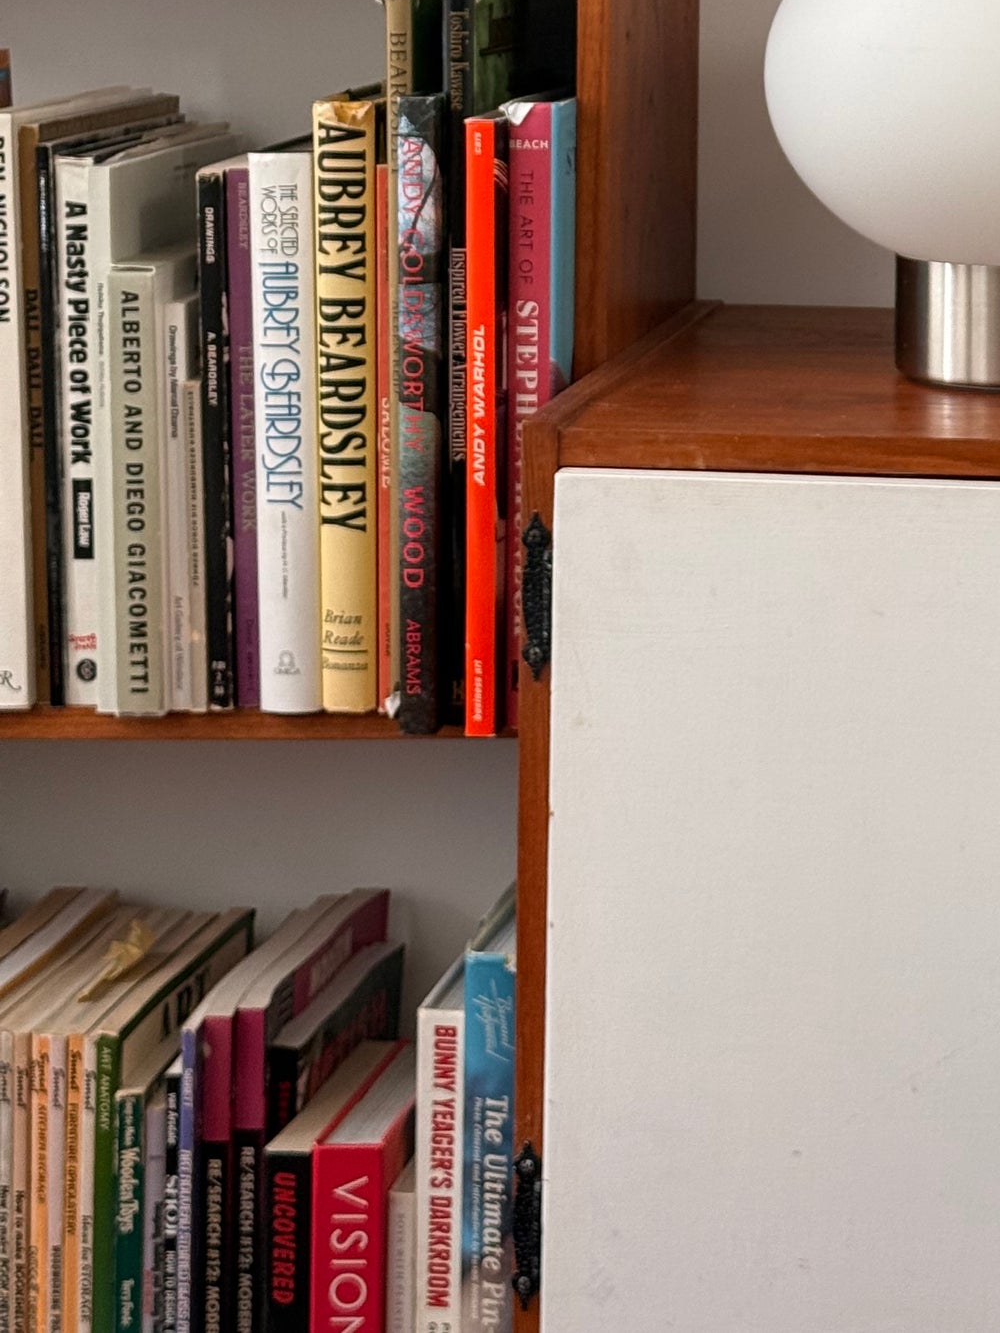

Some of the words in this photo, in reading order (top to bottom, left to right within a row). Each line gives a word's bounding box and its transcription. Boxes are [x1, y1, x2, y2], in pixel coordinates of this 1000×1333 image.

[449, 8, 469, 57] Toshiro
[449, 61, 469, 110] Kawase
[509, 140, 549, 151] BEACH
[279, 184, 298, 202] THE
[318, 121, 367, 283] AUBREY
[402, 137, 424, 218] ANDY
[520, 171, 534, 205] THE
[65, 201, 87, 218] A
[205, 207, 215, 264] DRAWINGS
[260, 186, 278, 236] WORKS
[279, 206, 299, 258] SELECTED
[520, 215, 534, 250] ART
[64, 224, 89, 292] Nasty
[260, 238, 279, 254] OF
[519, 259, 534, 284] OF
[448, 247, 467, 304] Inspired
[68, 298, 91, 364] Piece
[258, 261, 301, 356] AUBREY
[452, 310, 467, 357] Flower
[121, 291, 142, 394] ALBERTO
[167, 325, 179, 366] Drawings
[240, 342, 254, 392] THE
[402, 228, 425, 454] GOLDSWORTHY
[70, 370, 92, 394] of
[207, 345, 218, 406] BEARDSLEY
[473, 324, 485, 418] WARHOL
[71, 401, 94, 465] Work
[124, 404, 143, 450] AND
[241, 394, 255, 462] LATER
[260, 358, 304, 510] BEARDSLEY
[319, 296, 368, 533] BEARDSLEY
[451, 360, 467, 462] Arrangements
[473, 423, 485, 486] ANDY
[77, 492, 91, 523] Roger
[126, 462, 146, 533] DIEGO
[241, 469, 257, 531] WORK
[78, 525, 92, 546] Law
[403, 486, 425, 589] WOOD
[127, 543, 148, 694] GIACOMETTI
[323, 631, 365, 646] Reade
[324, 609, 363, 625] Brian
[405, 619, 422, 695] ABRAMS
[70, 1050, 82, 1093] Sunset
[101, 1046, 112, 1070] ART
[431, 1025, 458, 1091] BUNNY
[85, 1068, 97, 1114] Sunset
[100, 1074, 111, 1131] ANATOMY
[482, 1095, 509, 1144] The
[38, 1104, 48, 1151] KITCHEN
[68, 1102, 79, 1165] FURNITURE
[430, 1097, 456, 1188] YEAGER'S
[119, 1147, 140, 1201] Wooden
[206, 1159, 222, 1245] RE/SEARCH
[239, 1146, 255, 1231] RE/SEARCH
[115, 1200, 139, 1234] Toys
[272, 1172, 298, 1305] UNCOVERED
[482, 1153, 509, 1270] Ultimate
[164, 1250, 177, 1273] HOW
[427, 1194, 454, 1308] DARKROOM
[80, 1264, 92, 1323] STORAGE
[164, 1276, 176, 1288] TO
